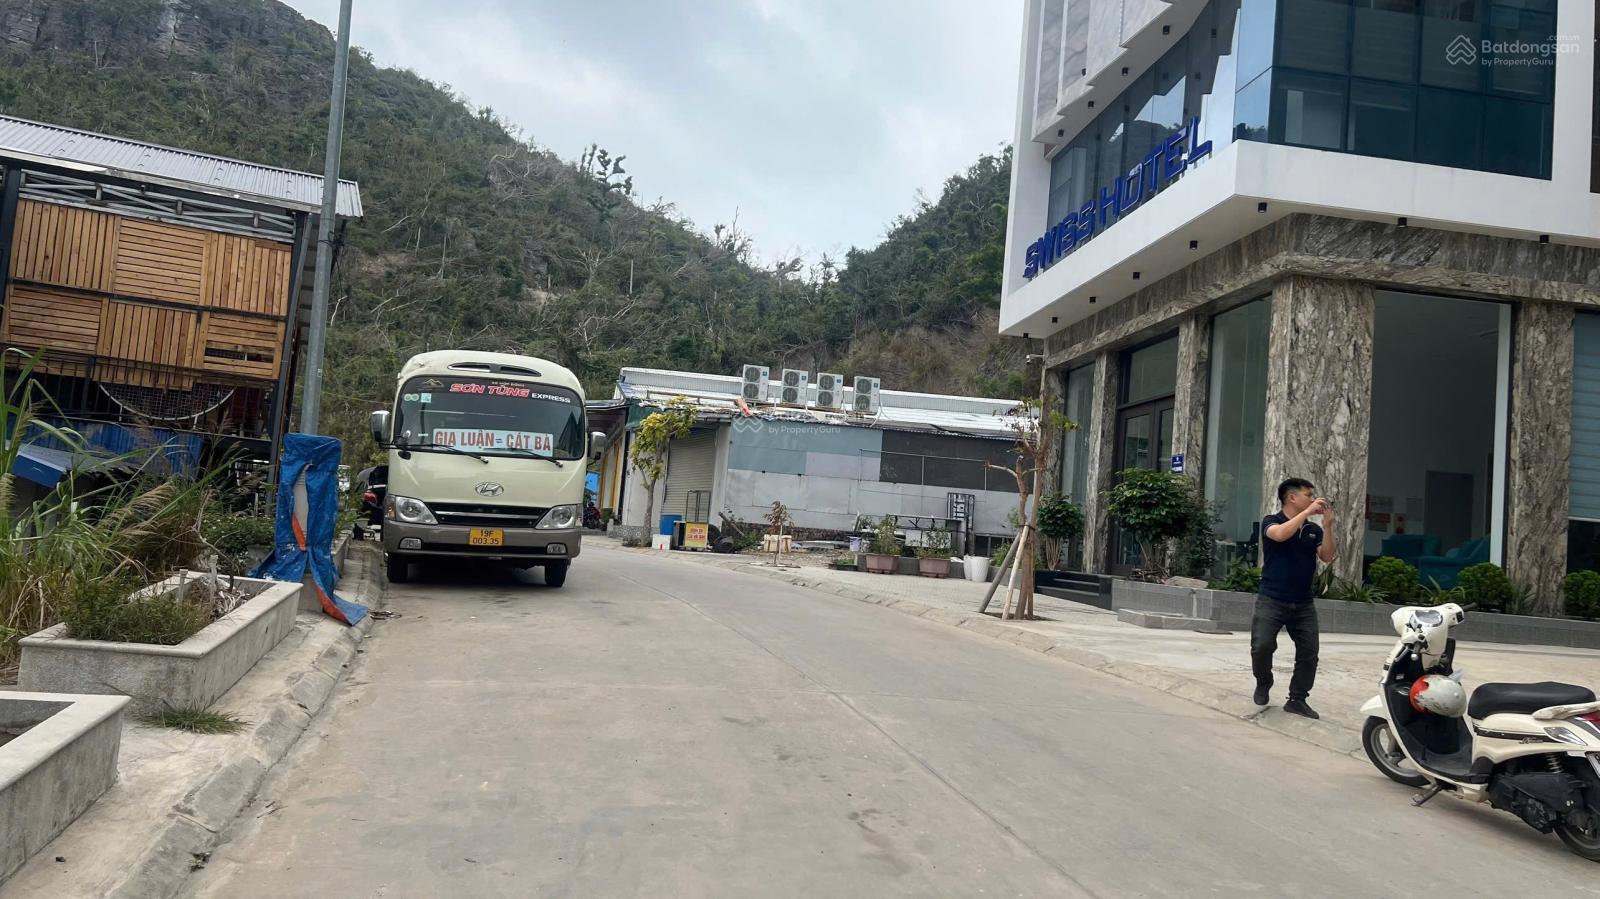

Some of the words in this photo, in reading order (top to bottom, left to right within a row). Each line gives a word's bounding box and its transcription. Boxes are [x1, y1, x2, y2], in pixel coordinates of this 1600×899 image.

[1023, 200, 1096, 278] SWISS
[1100, 116, 1213, 225] HOTEL
[532, 392, 571, 403] EXPRESS
[434, 431, 457, 446] GIA
[506, 432, 530, 449] CÁT
